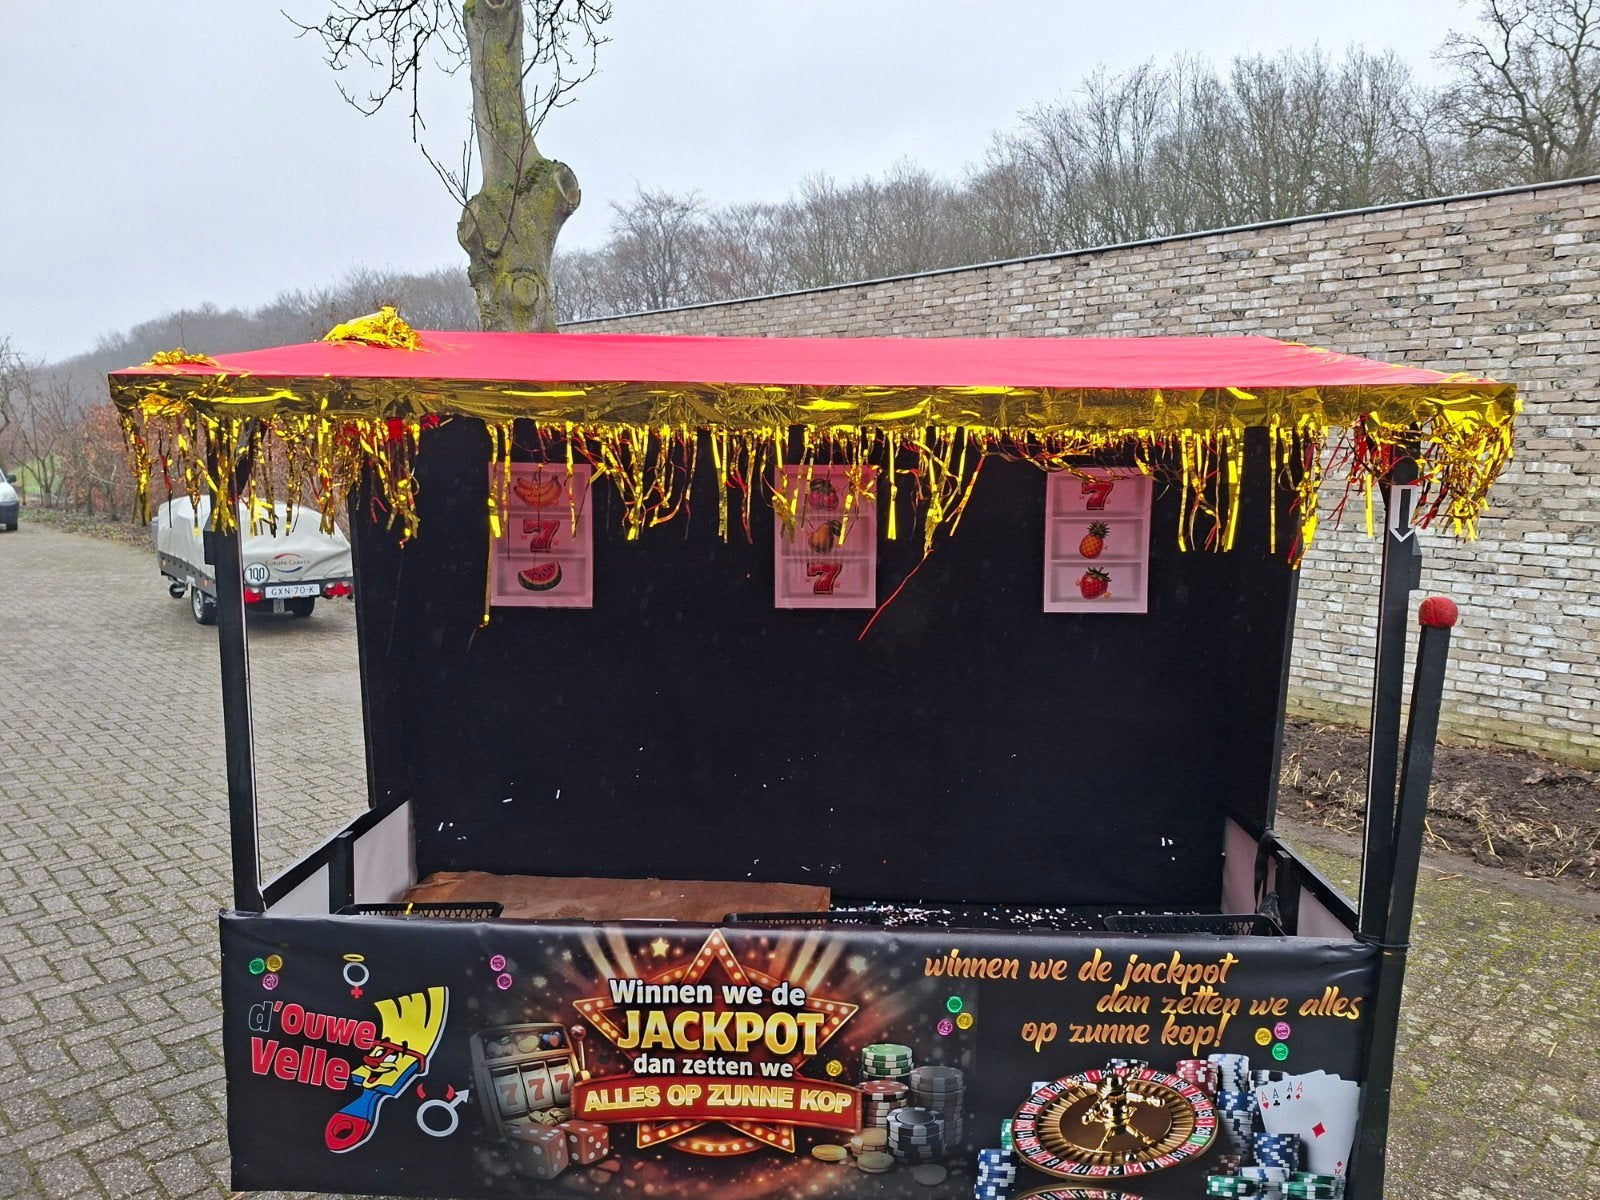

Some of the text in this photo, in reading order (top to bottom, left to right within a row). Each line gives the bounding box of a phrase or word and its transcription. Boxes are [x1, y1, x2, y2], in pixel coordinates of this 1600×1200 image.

[1082, 481, 1114, 511] 7
[523, 519, 561, 553] 7
[249, 567, 265, 580] 100
[807, 562, 843, 595] 7
[271, 586, 315, 596] GXN-70-K
[924, 948, 1239, 996] winnen we de jackpot
[609, 979, 806, 1006] Winnen we de
[1096, 984, 1363, 1020] dan zetten we alles
[248, 1001, 377, 1050] d'Ouwe
[617, 1010, 825, 1055] JACKPOT
[1021, 1012, 1231, 1057] op zunne kop!
[251, 1037, 351, 1091] Velle
[633, 1053, 794, 1078] dan zetten we
[1144, 1071, 1150, 1079] 9
[1155, 1073, 1166, 1082] 22
[500, 1073, 570, 1106] 7 7 7
[584, 1084, 852, 1114] ALLES OP ZUNNE KOP
[1050, 1083, 1064, 1092] 24
[1261, 1082, 1304, 1101] A A A A
[1073, 1165, 1088, 1173] 17
[1091, 1166, 1105, 1174] 25
[1112, 1166, 1120, 1175] 2
[1127, 1163, 1140, 1174] 21
